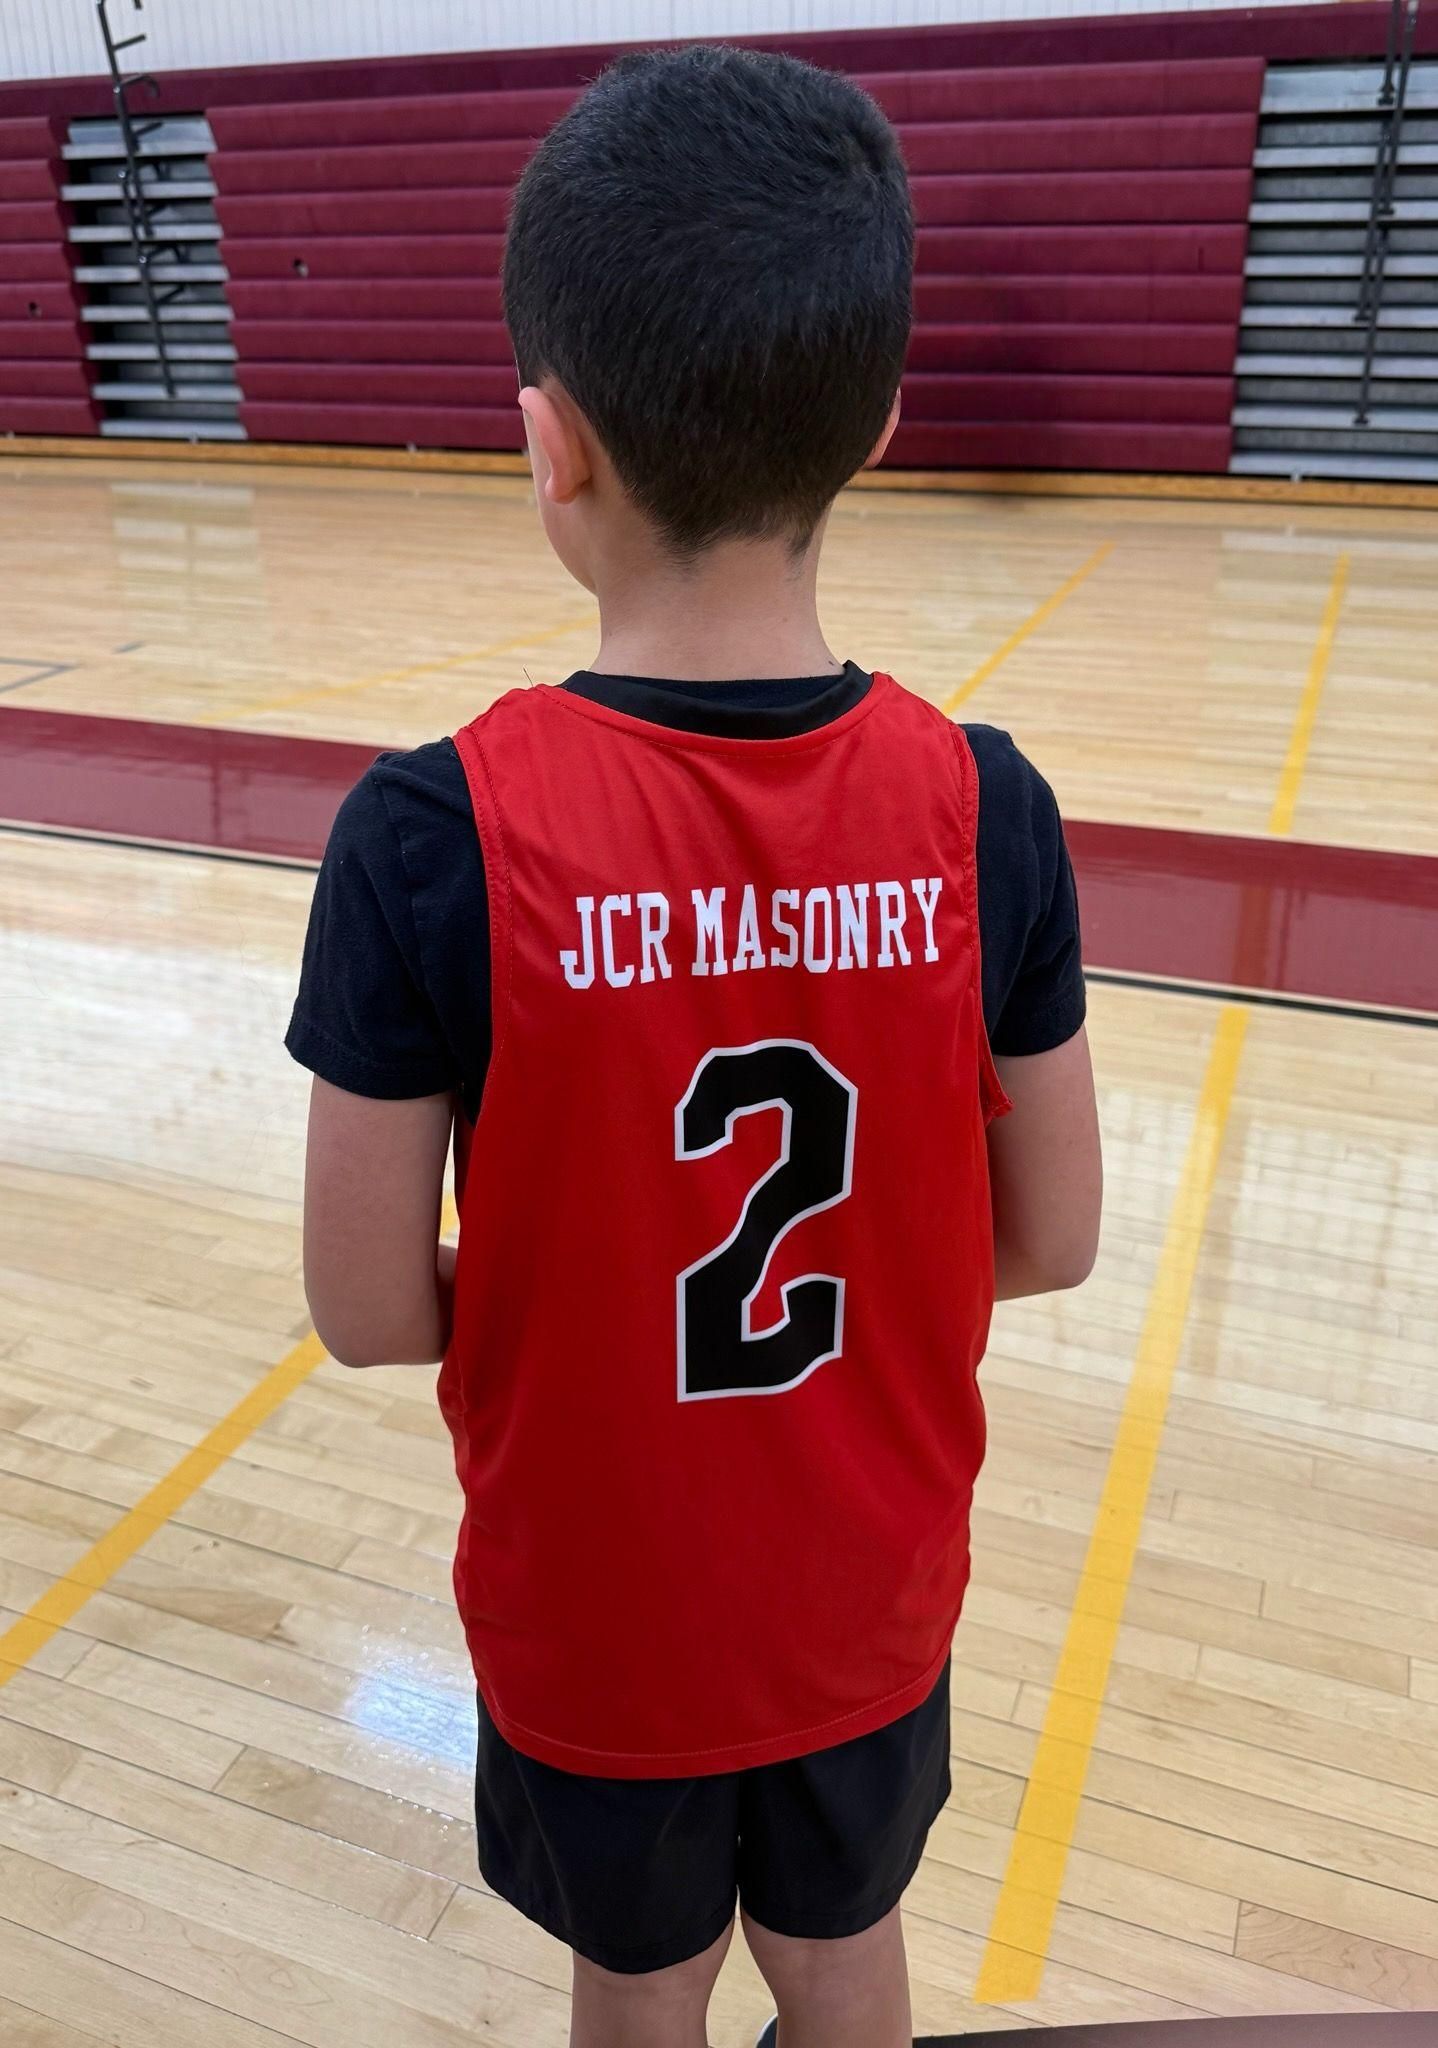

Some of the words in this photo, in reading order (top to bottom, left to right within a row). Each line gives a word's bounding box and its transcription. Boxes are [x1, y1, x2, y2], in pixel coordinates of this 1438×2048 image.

[560, 892, 672, 988] JCR
[692, 878, 943, 976] MASONRY
[675, 1039, 858, 1402] 2
